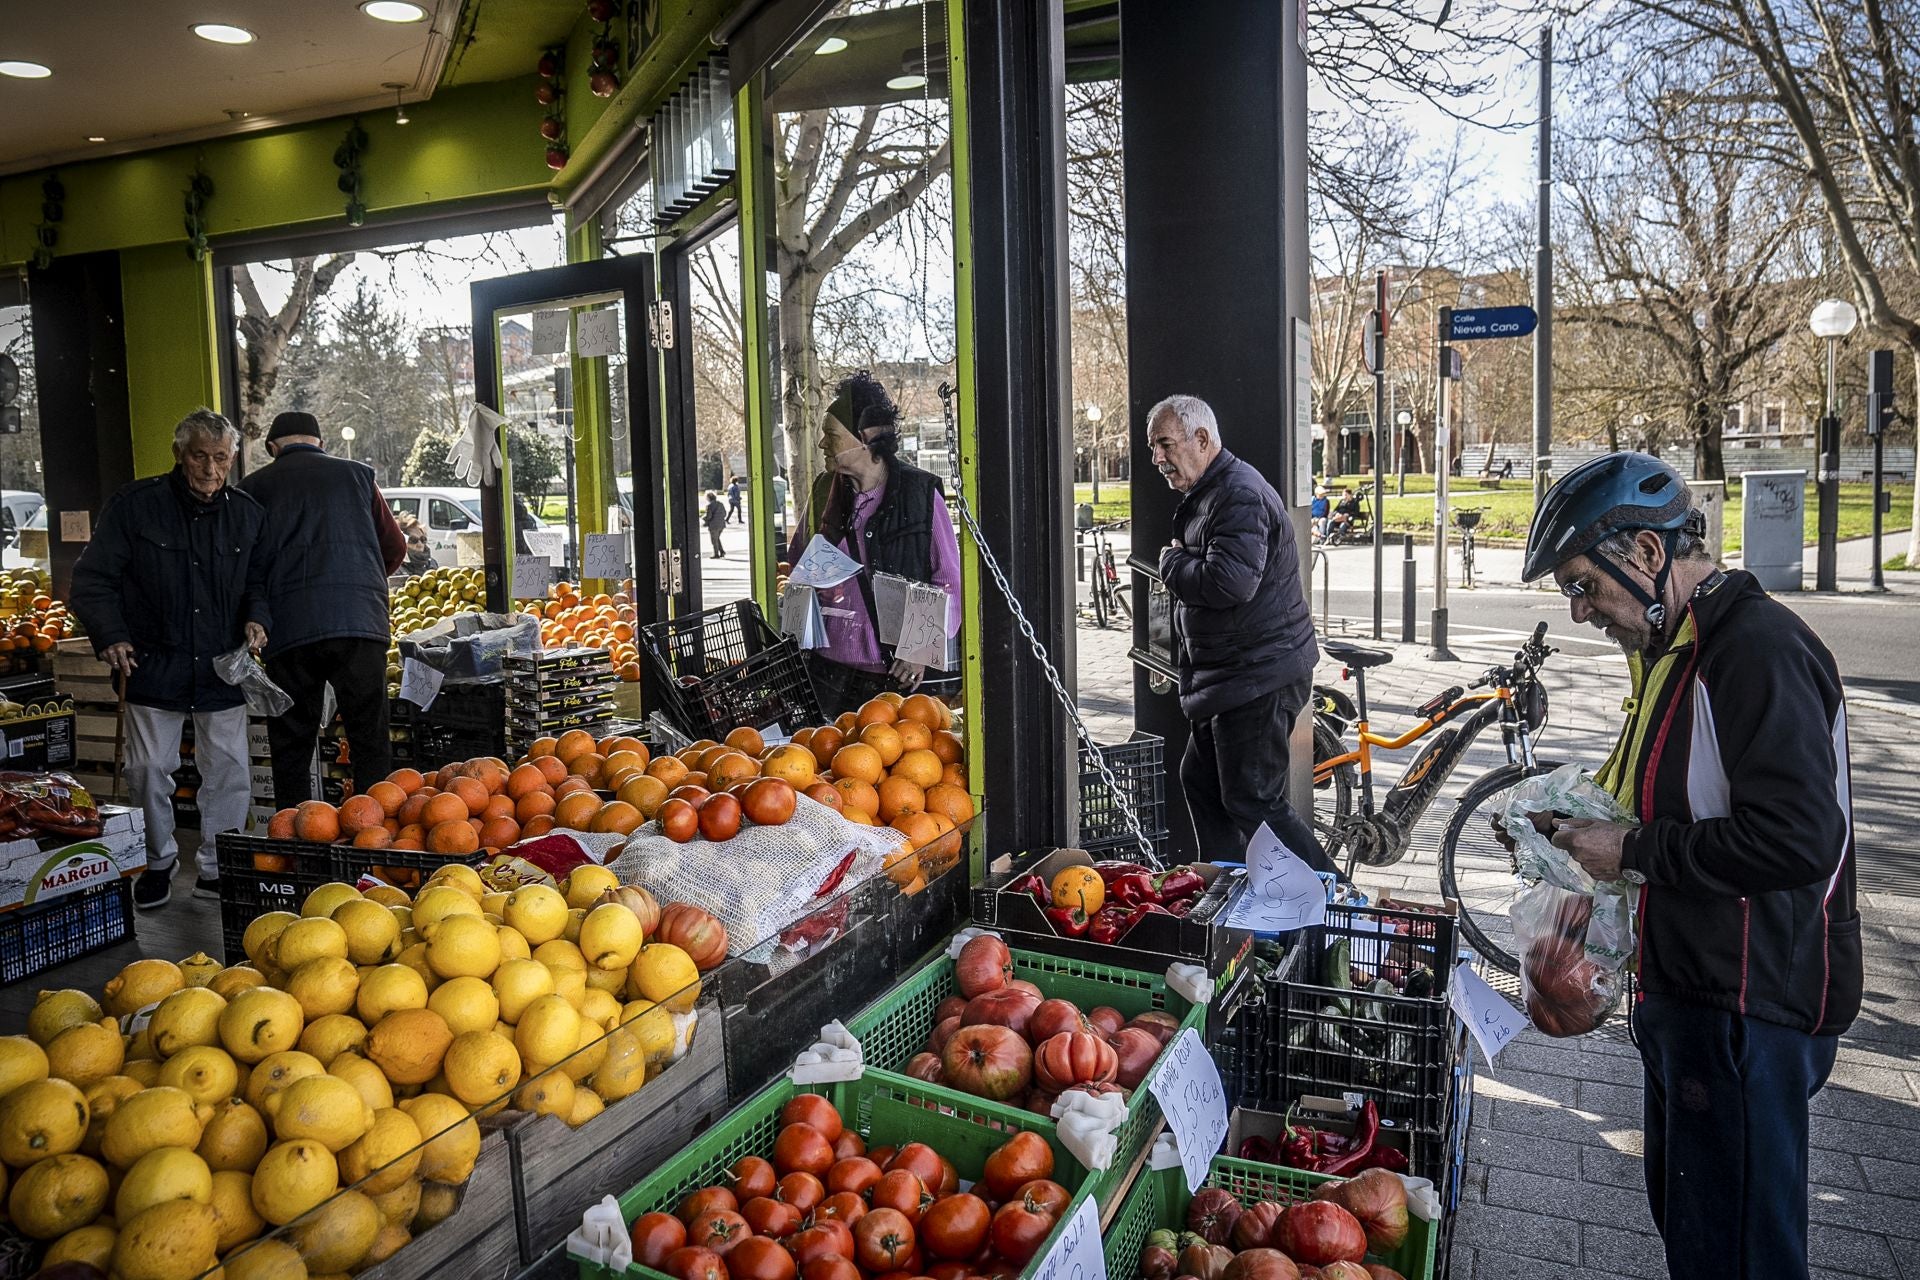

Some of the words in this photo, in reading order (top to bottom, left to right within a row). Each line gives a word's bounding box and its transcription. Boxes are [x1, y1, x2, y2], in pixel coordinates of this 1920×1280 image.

[583, 312, 598, 323] UVA
[1454, 315, 1475, 323] Calle
[1453, 325, 1487, 334] Nieves
[1490, 323, 1519, 332] Cano
[41, 860, 110, 891] MARGUI
